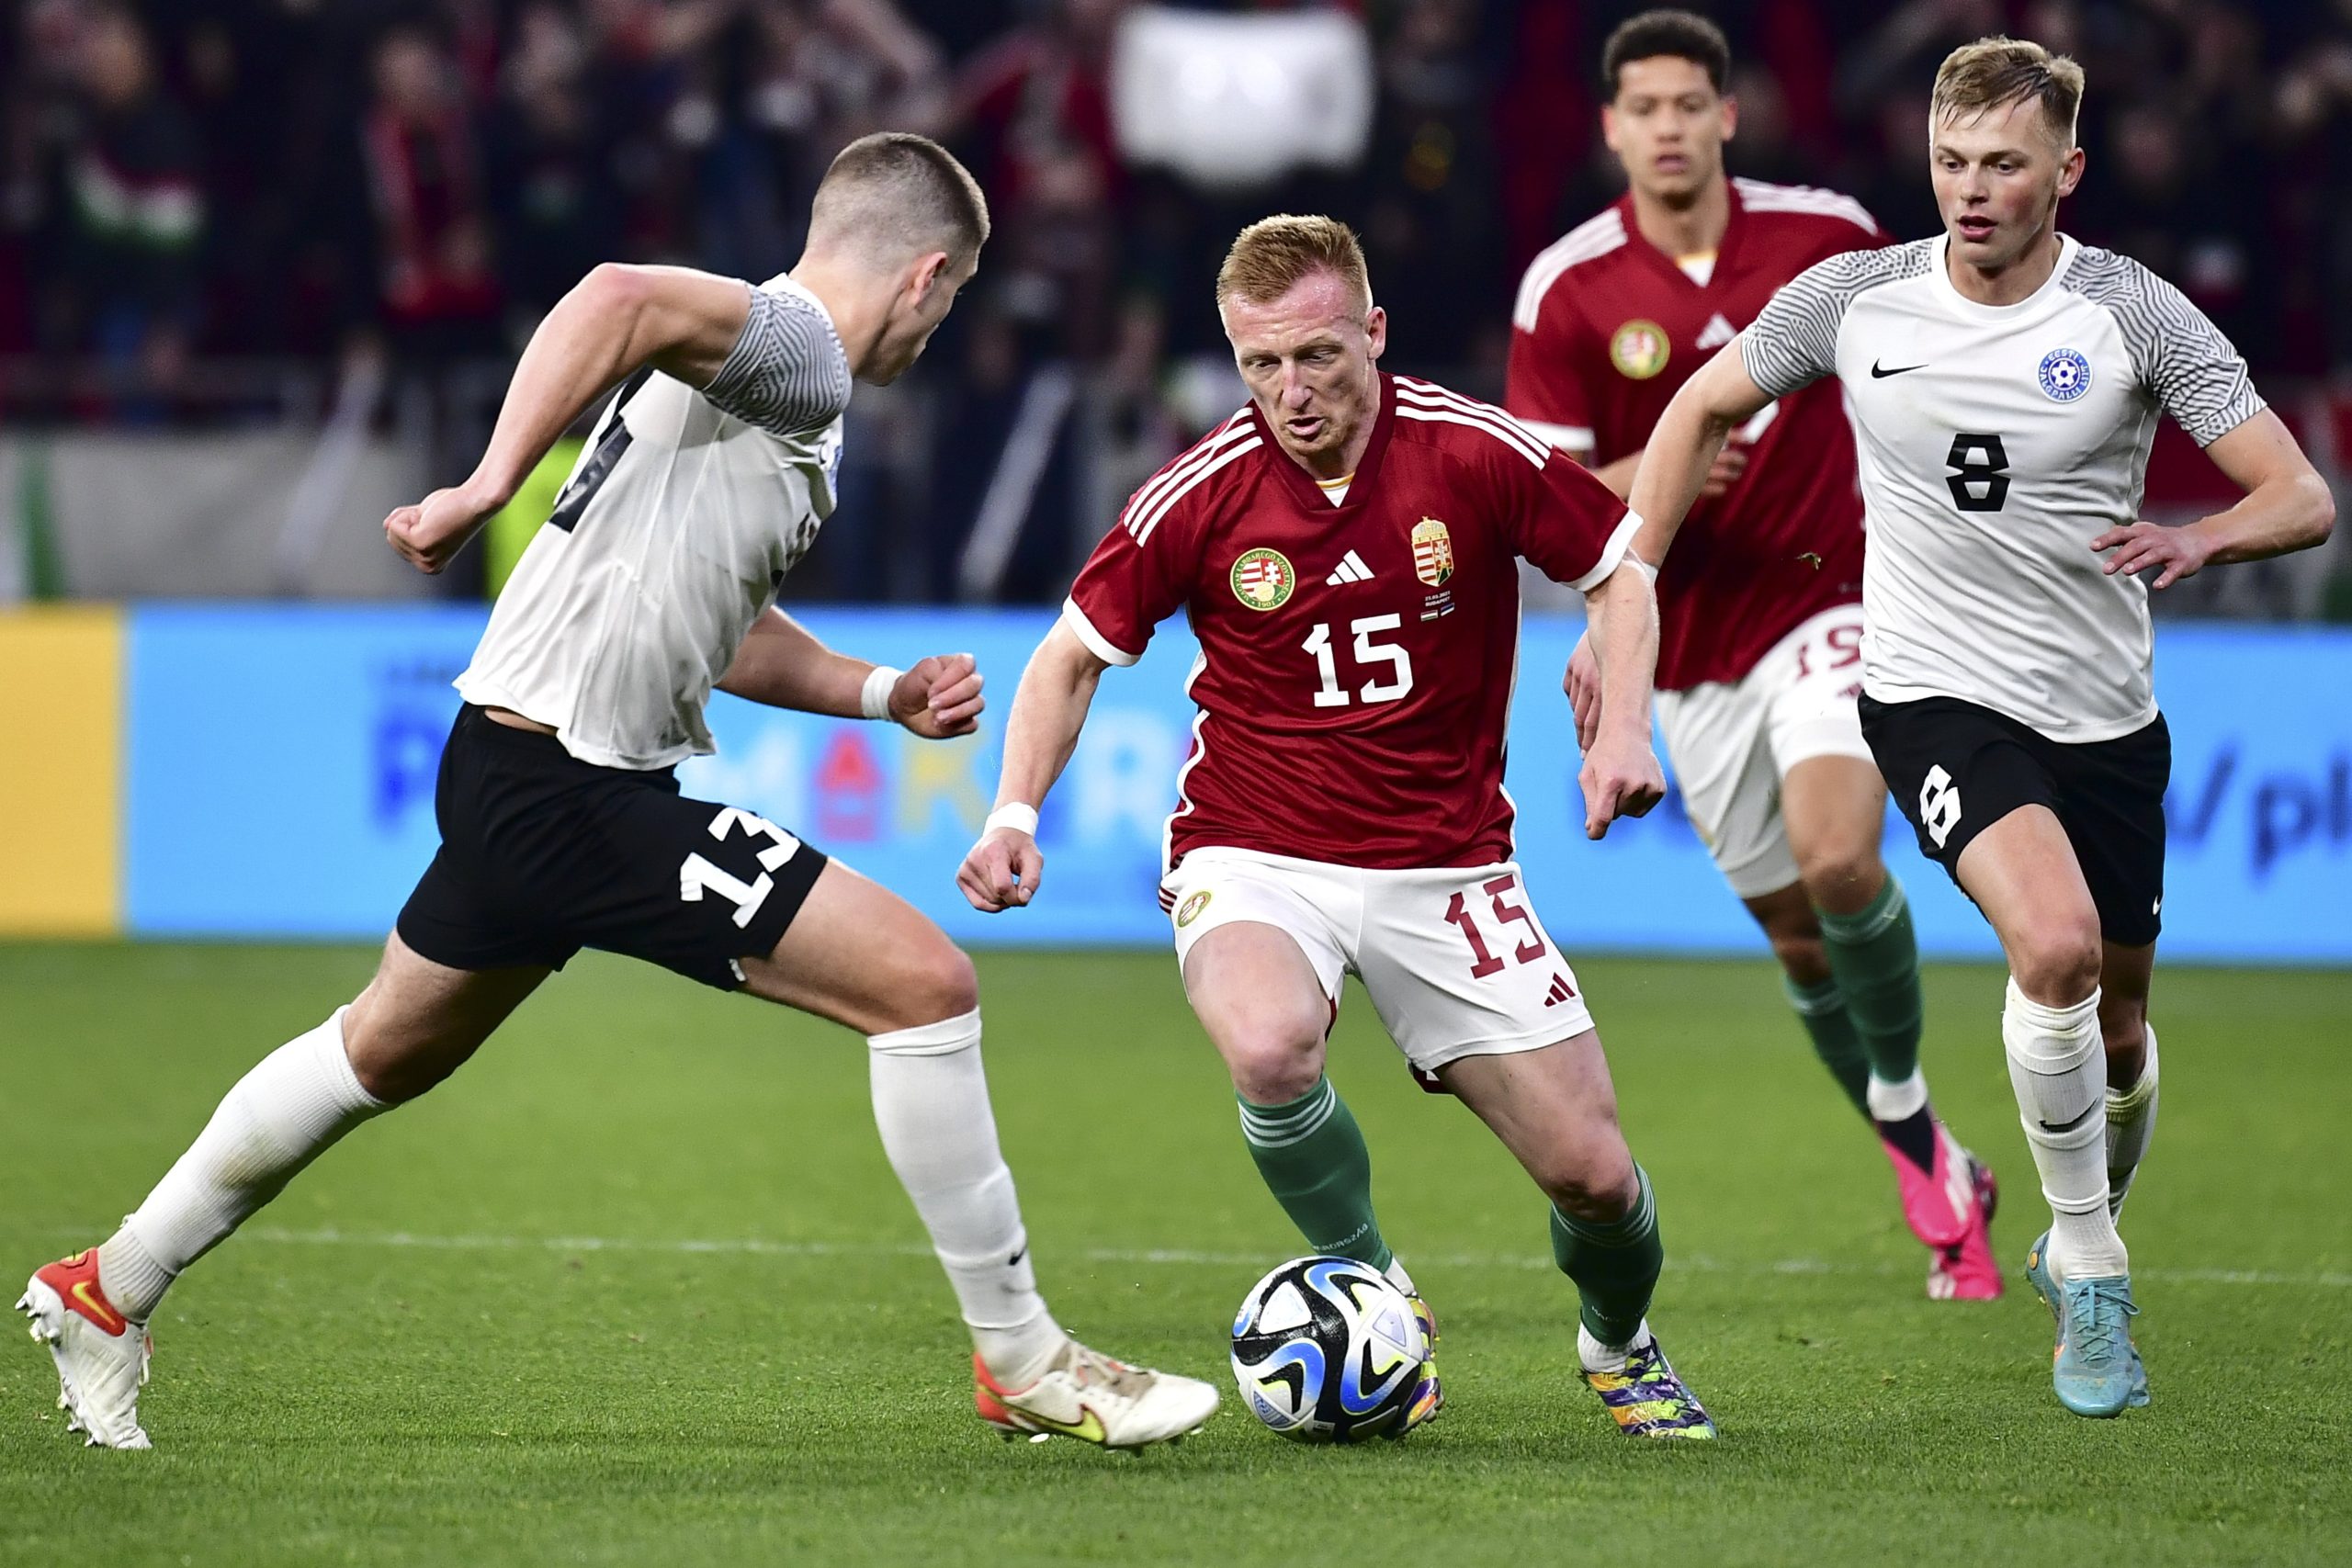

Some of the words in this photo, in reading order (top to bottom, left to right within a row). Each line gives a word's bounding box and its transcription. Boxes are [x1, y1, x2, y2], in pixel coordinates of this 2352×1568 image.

[2040, 367, 2082, 400] JALGPALLI
[2080, 365, 2089, 387] LIIT
[2048, 349, 2078, 360] EESTI
[1945, 433, 2011, 512] 8
[1301, 613, 1414, 707] 15
[1919, 764, 1962, 850] 8
[680, 807, 801, 930] 13
[1444, 874, 1545, 979] 15
